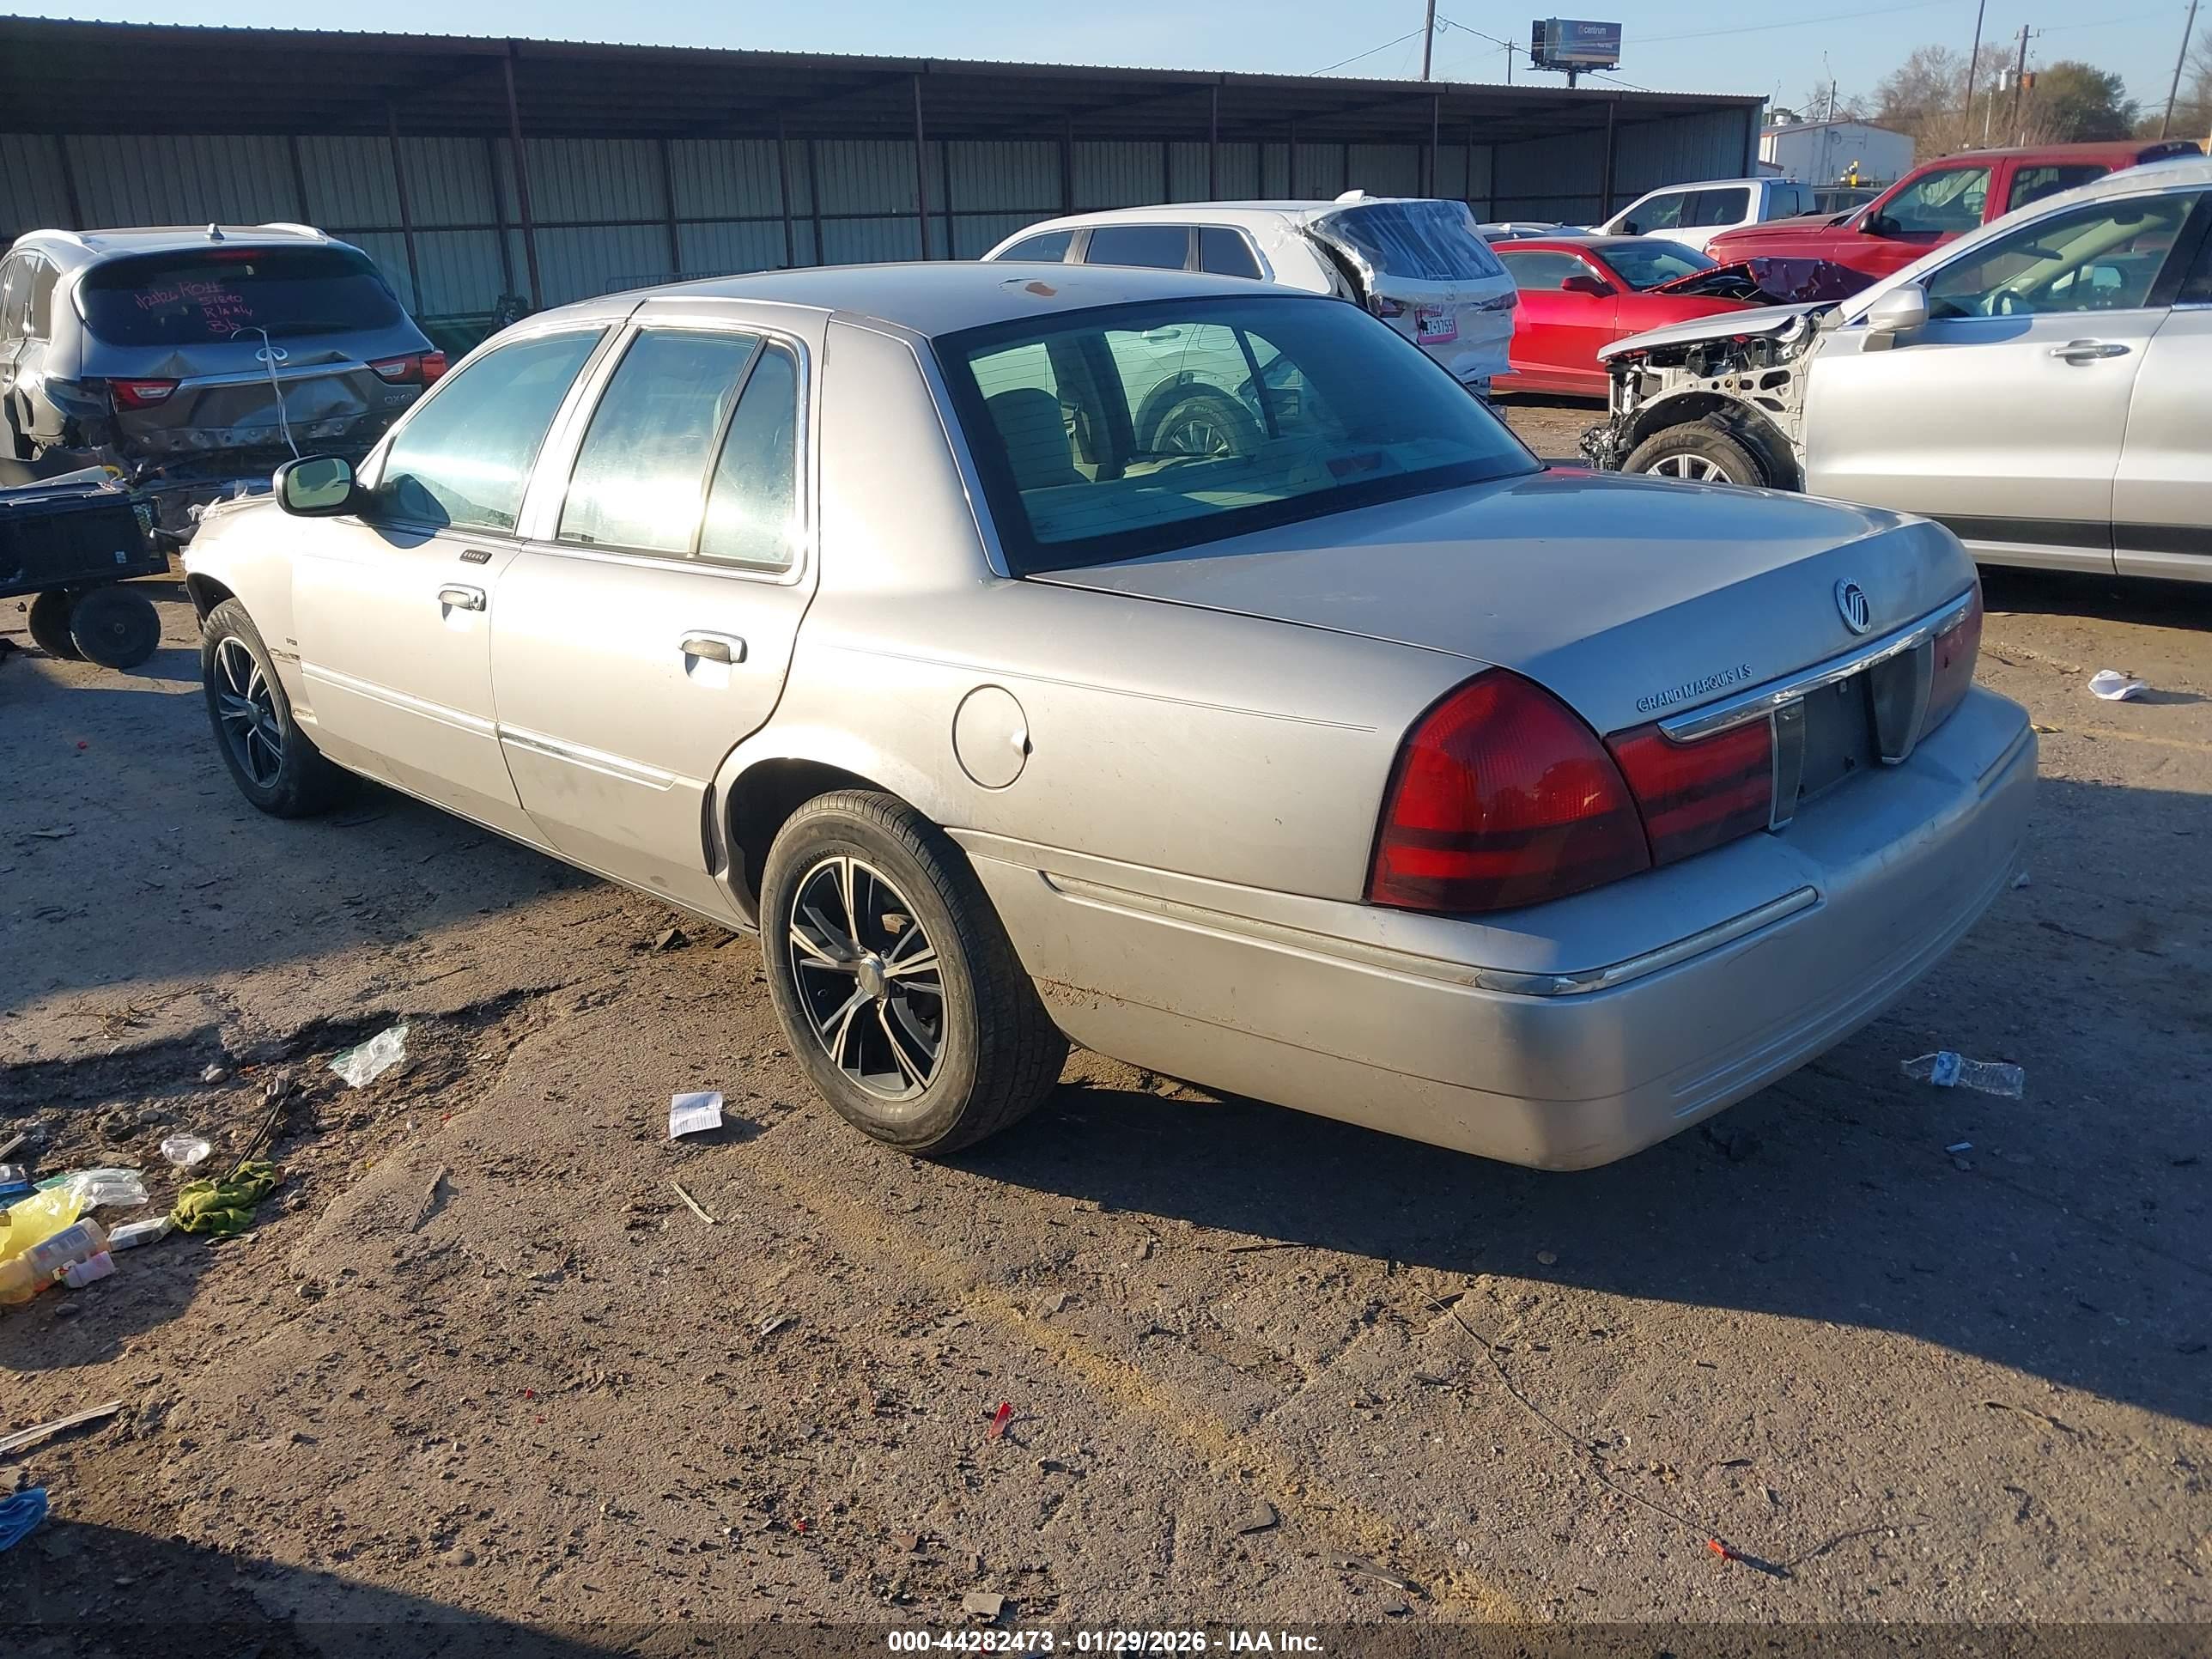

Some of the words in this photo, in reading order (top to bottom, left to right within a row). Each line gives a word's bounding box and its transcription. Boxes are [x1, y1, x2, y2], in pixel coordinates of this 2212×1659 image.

[1637, 689, 1682, 713] GRAND
[1682, 669, 1735, 698] MARQUIS
[1736, 664, 1753, 681] LS
